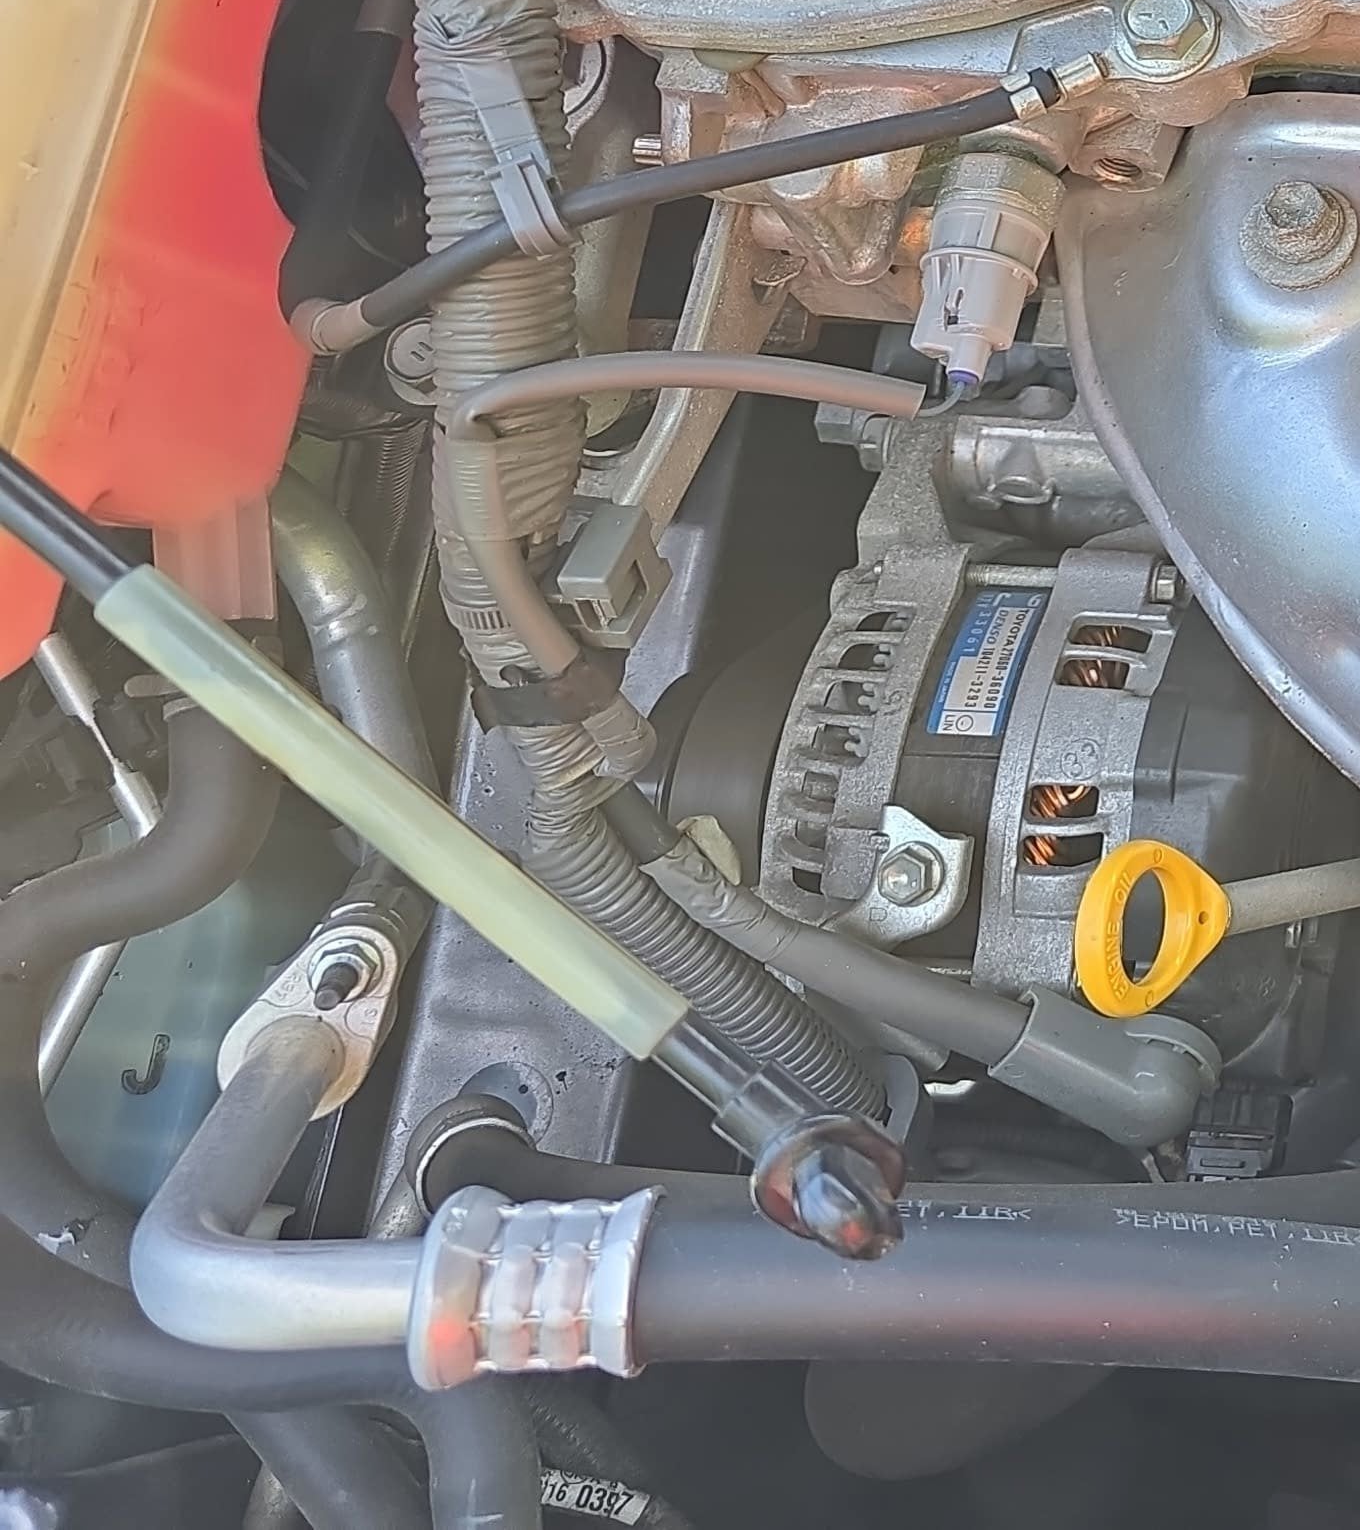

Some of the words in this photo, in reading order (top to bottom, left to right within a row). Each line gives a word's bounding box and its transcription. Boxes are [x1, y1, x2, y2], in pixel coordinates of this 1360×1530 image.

[962, 610, 993, 653] 33061
[986, 609, 1010, 646] DENSO
[1002, 608, 1030, 649] TOYOTA
[964, 646, 996, 709] 104211-3293
[943, 714, 957, 731] LIN
[1114, 870, 1135, 905] OIL
[1103, 920, 1130, 1002] ENGINE
